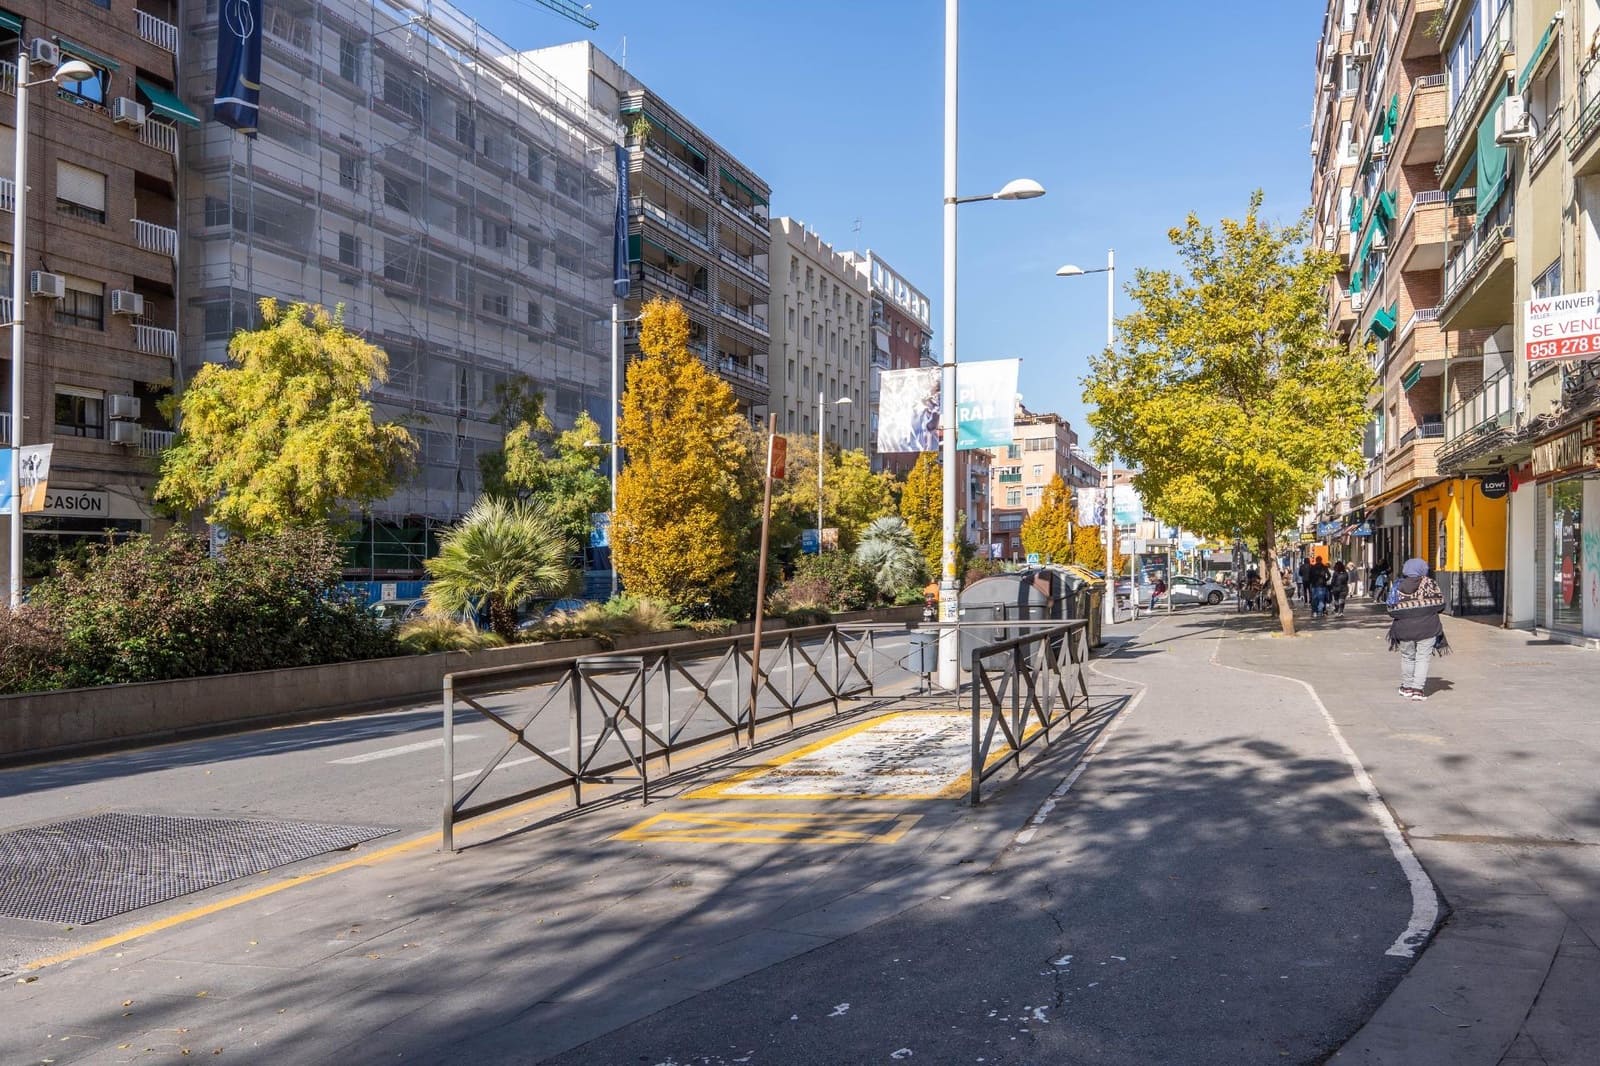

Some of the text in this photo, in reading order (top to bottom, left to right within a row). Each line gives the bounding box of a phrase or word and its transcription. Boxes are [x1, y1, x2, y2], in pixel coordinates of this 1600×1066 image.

[1530, 296, 1594, 314] kw KINVER
[1532, 323, 1554, 338] SE
[1530, 342, 1557, 357] 958
[1561, 337, 1589, 353] 278
